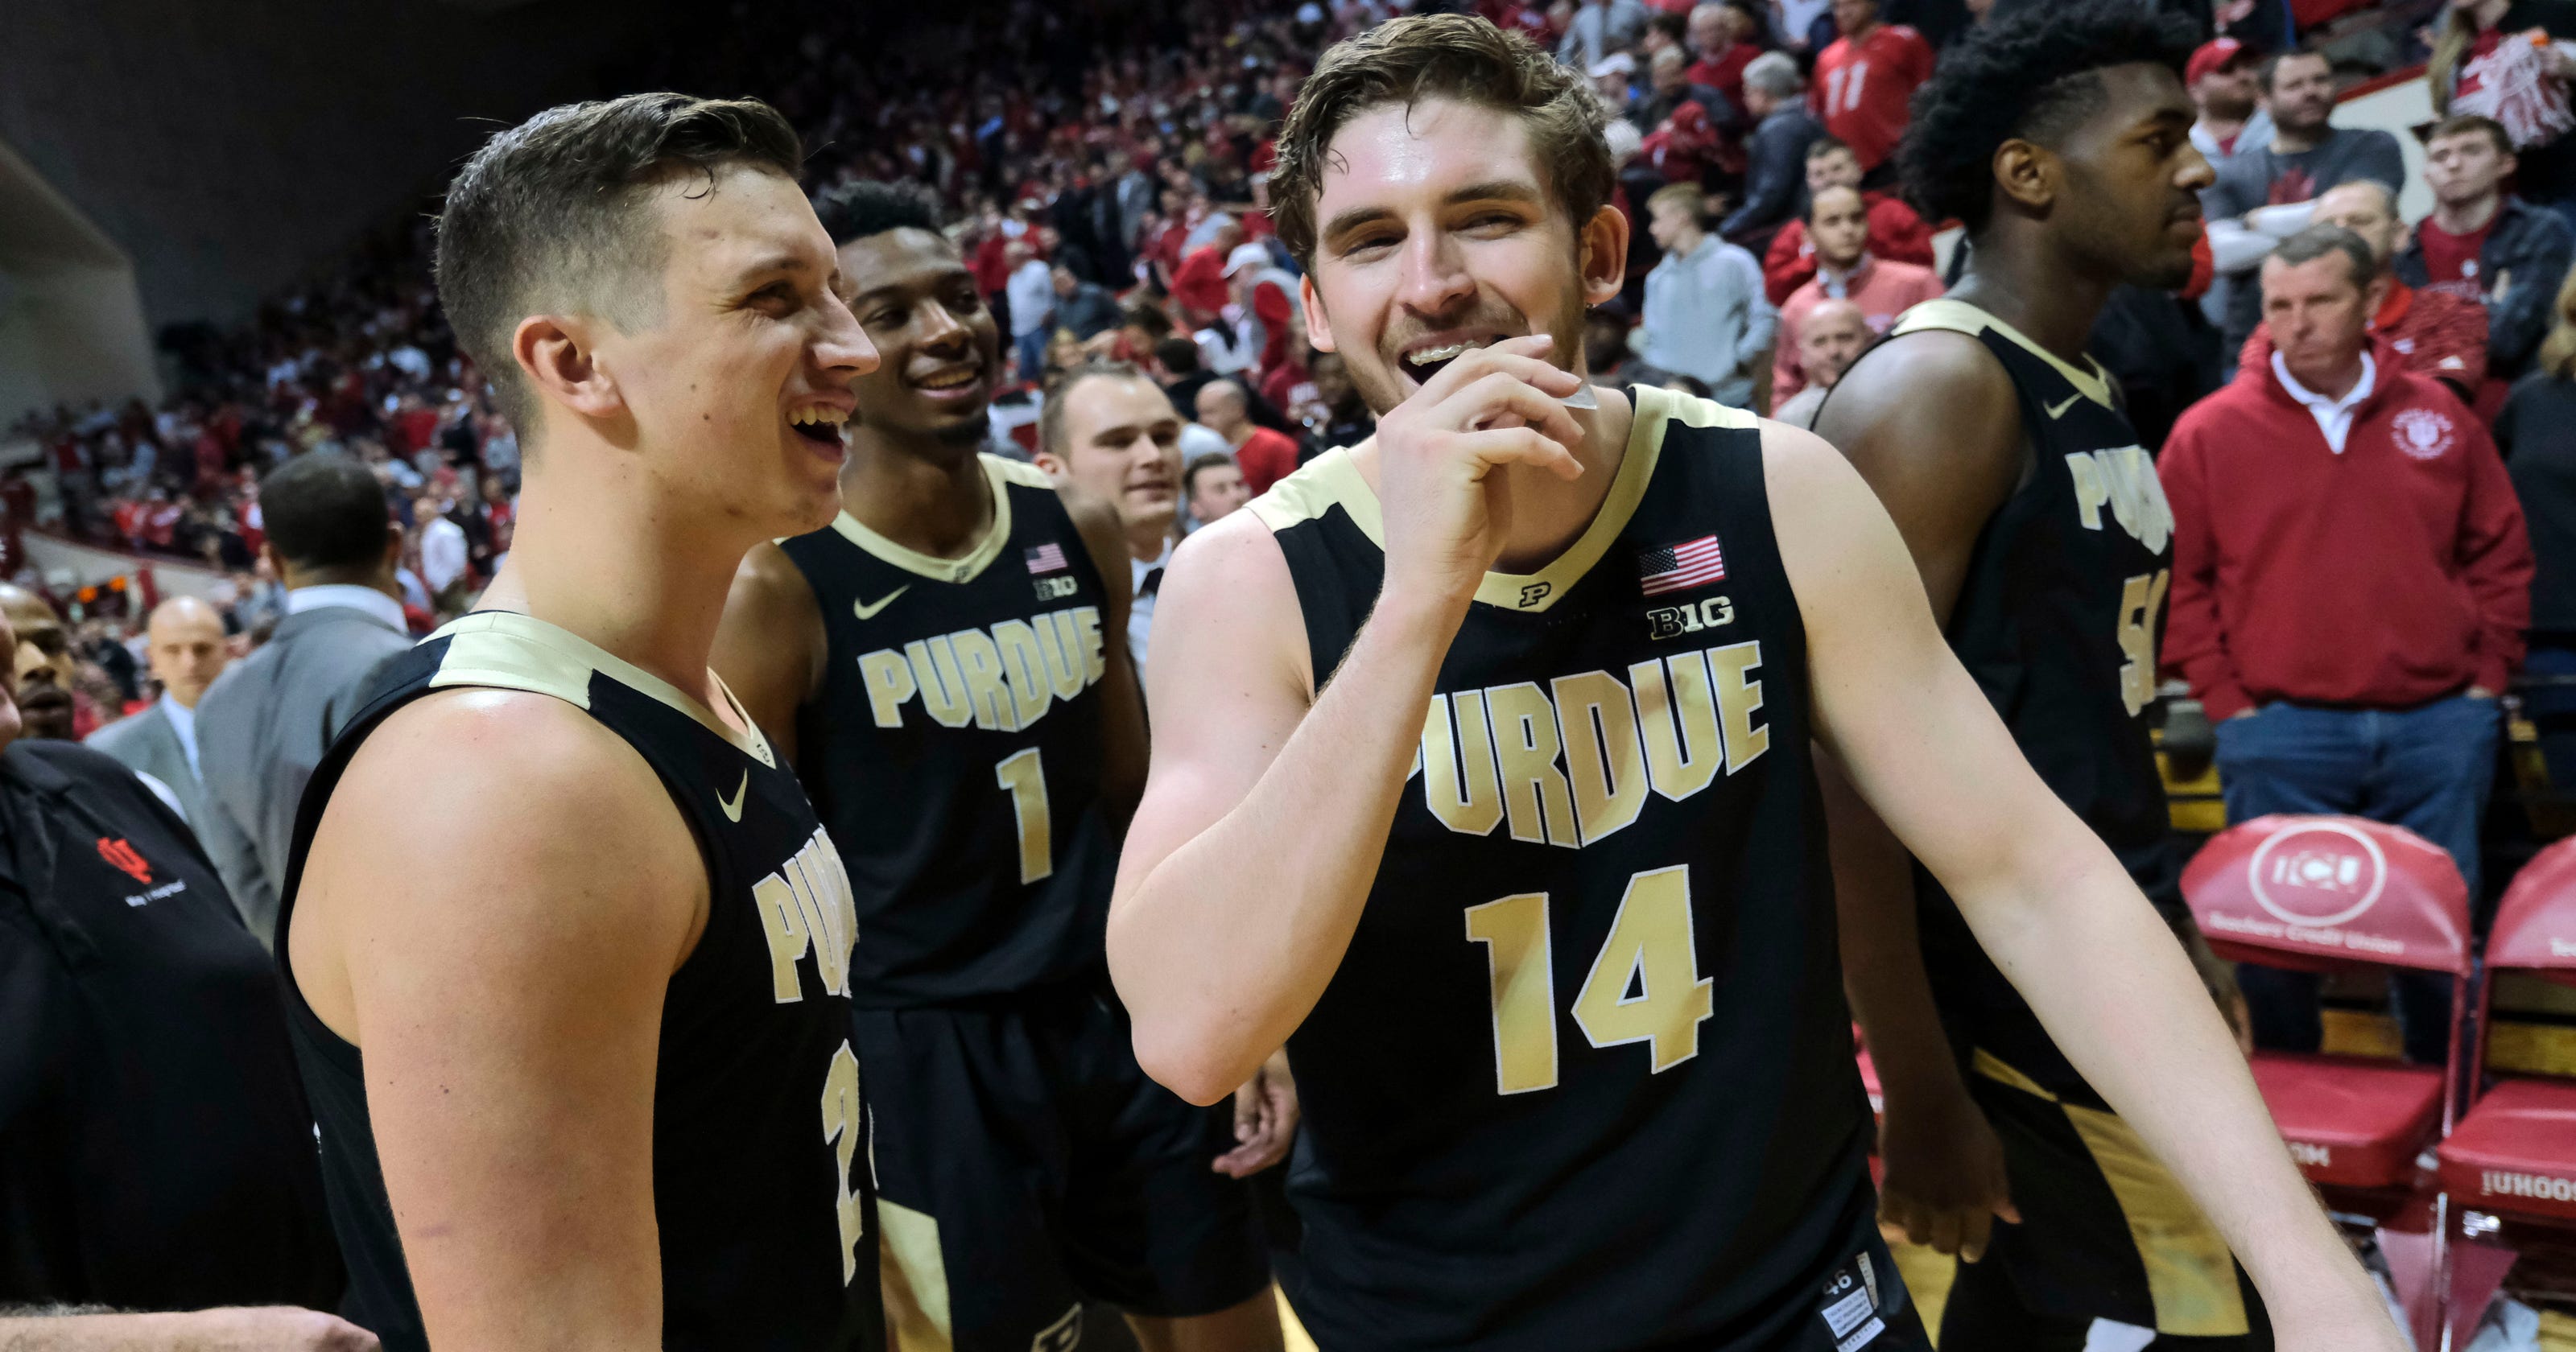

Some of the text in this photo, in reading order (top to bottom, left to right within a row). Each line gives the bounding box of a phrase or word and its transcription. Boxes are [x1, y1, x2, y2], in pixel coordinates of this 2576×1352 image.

[1518, 581, 1552, 608] P
[857, 605, 1106, 732] PURDUE
[1406, 640, 1770, 849] URDUE
[995, 746, 1054, 884] 1
[1464, 864, 1714, 1095] 14
[2481, 1171, 2576, 1202] IUHOO
